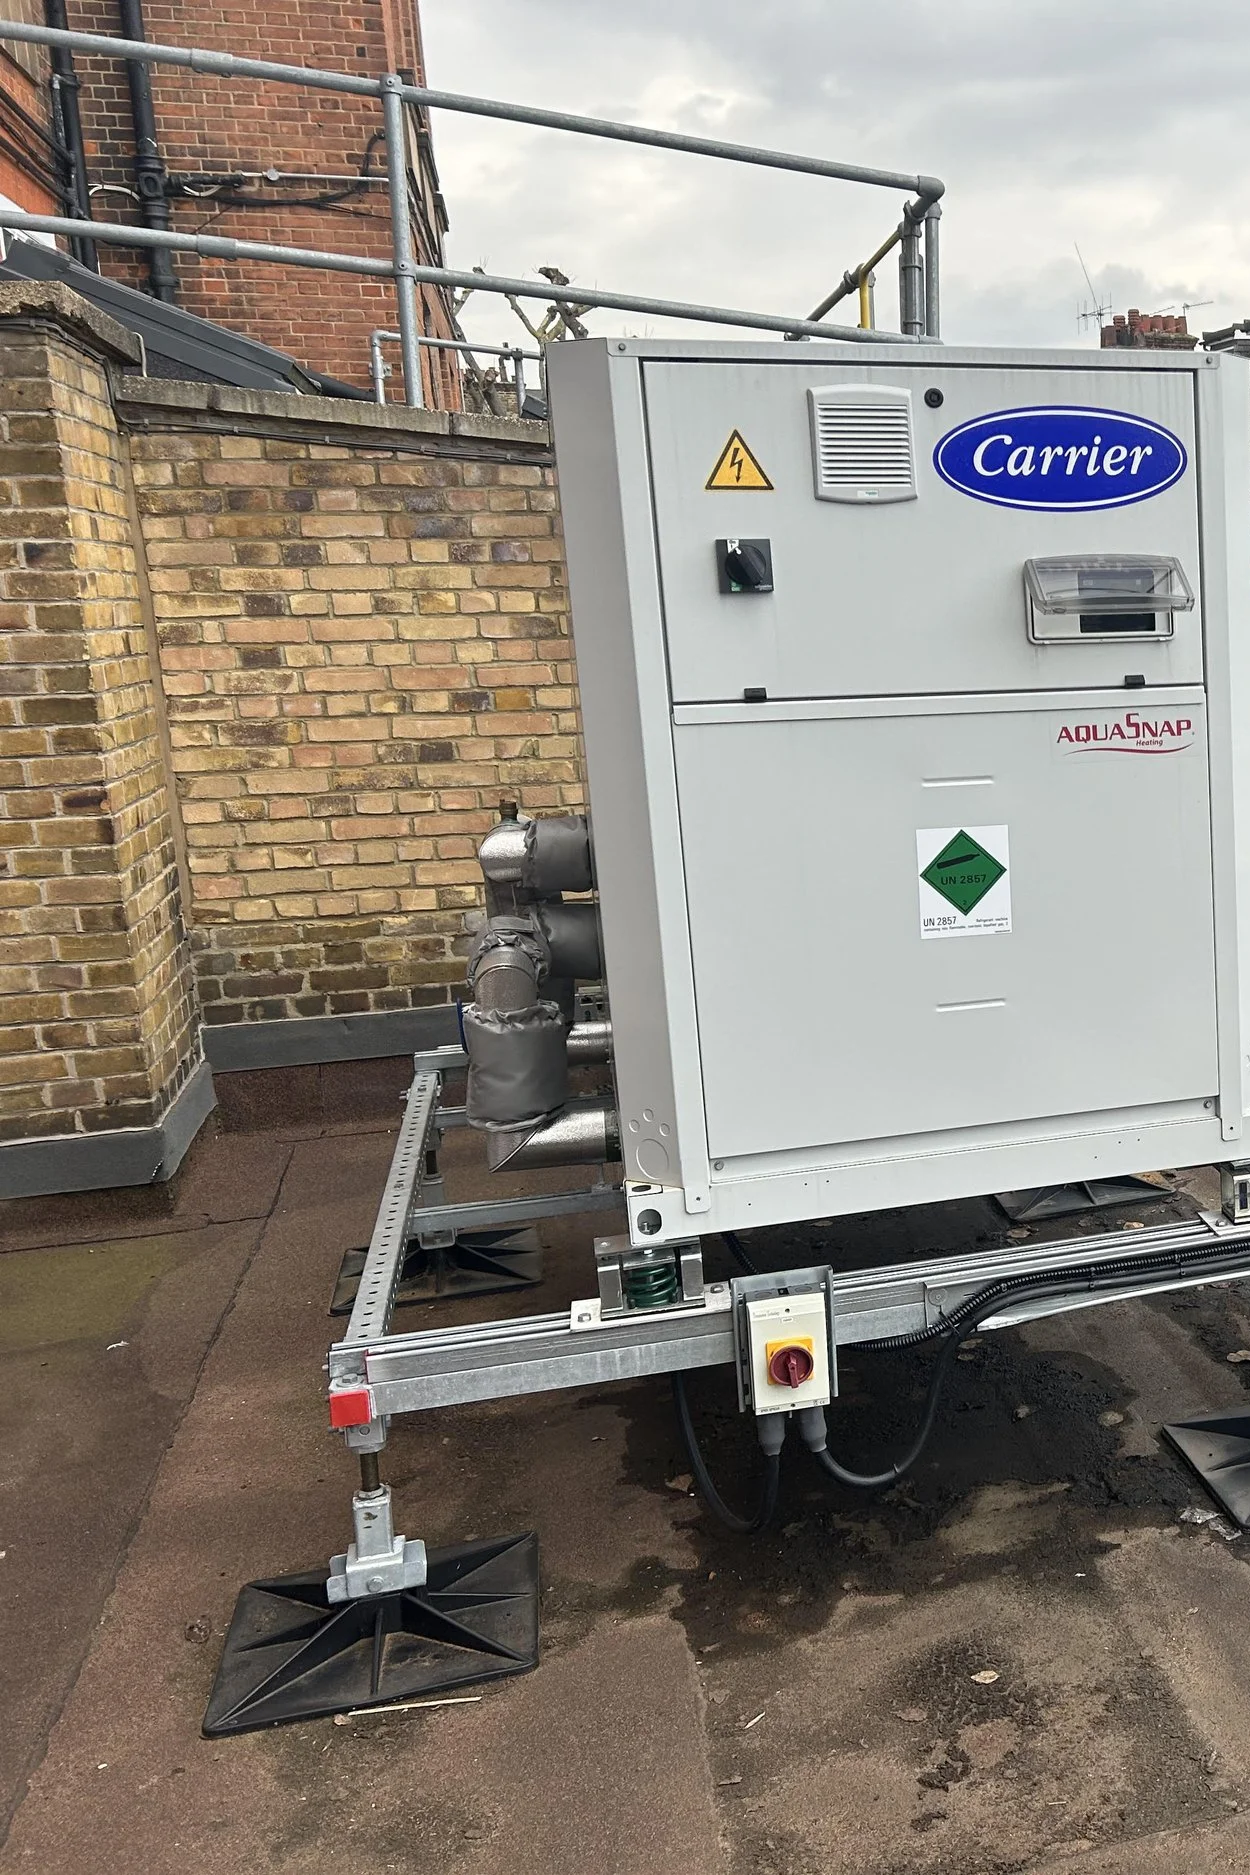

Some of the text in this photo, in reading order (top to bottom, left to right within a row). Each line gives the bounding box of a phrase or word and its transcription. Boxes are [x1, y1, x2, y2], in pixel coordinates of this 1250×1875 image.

[973, 434, 1153, 477] Carrier
[1136, 739, 1164, 747] Heating
[940, 874, 987, 885] UN 2857
[923, 918, 935, 927] UN
[937, 916, 957, 926] 2857
